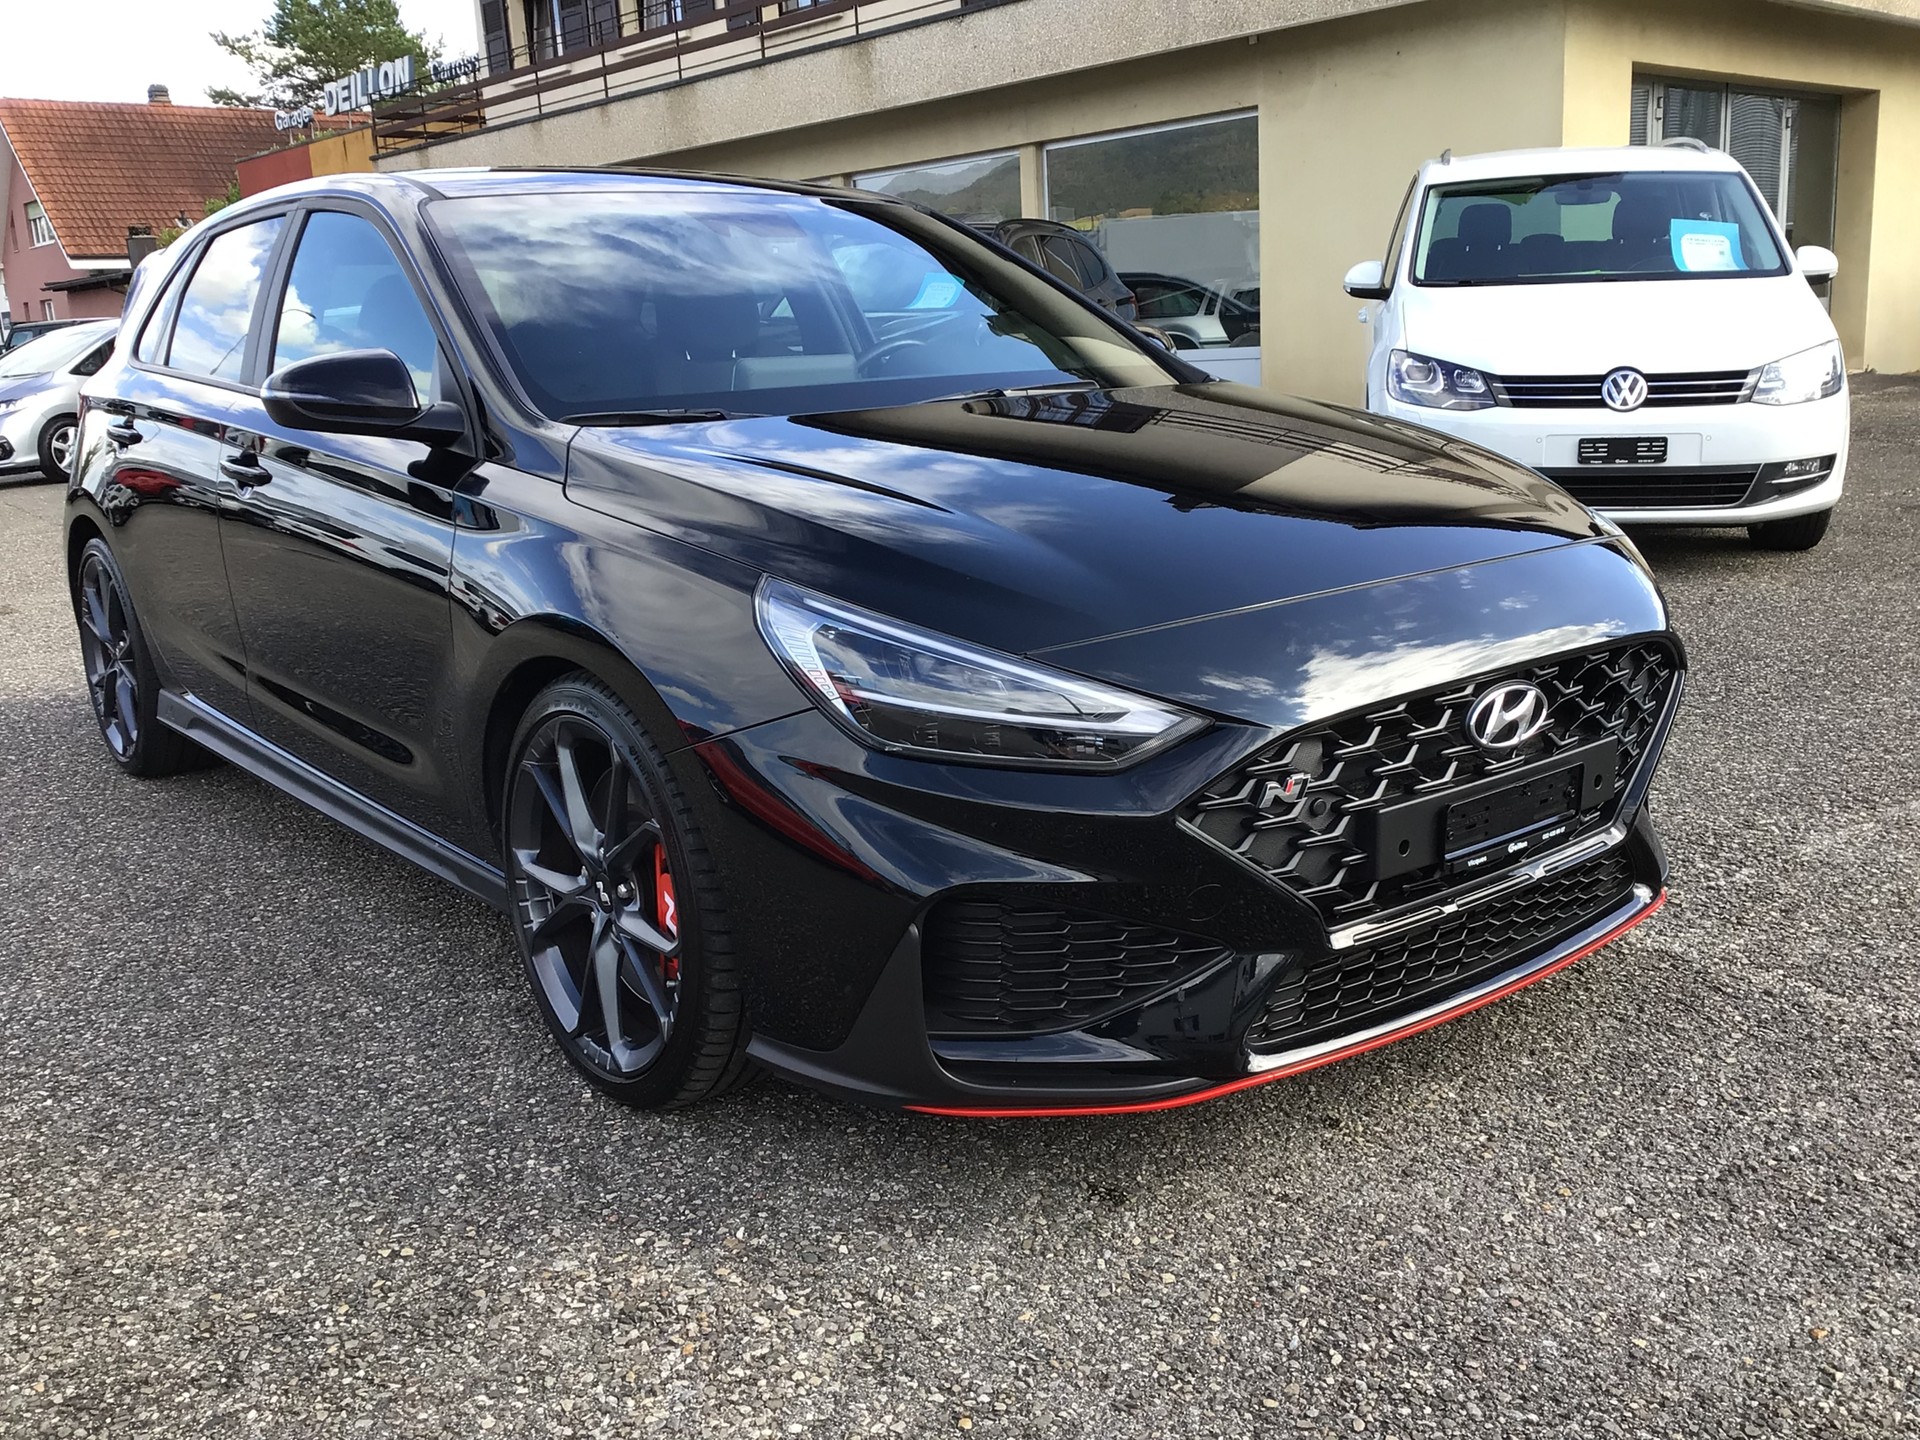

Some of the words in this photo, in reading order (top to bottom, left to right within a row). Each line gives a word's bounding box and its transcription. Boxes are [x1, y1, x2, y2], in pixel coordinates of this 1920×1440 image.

[274, 107, 312, 131] Garage
[324, 54, 413, 116] DEILLON
[1258, 772, 1311, 809] N
